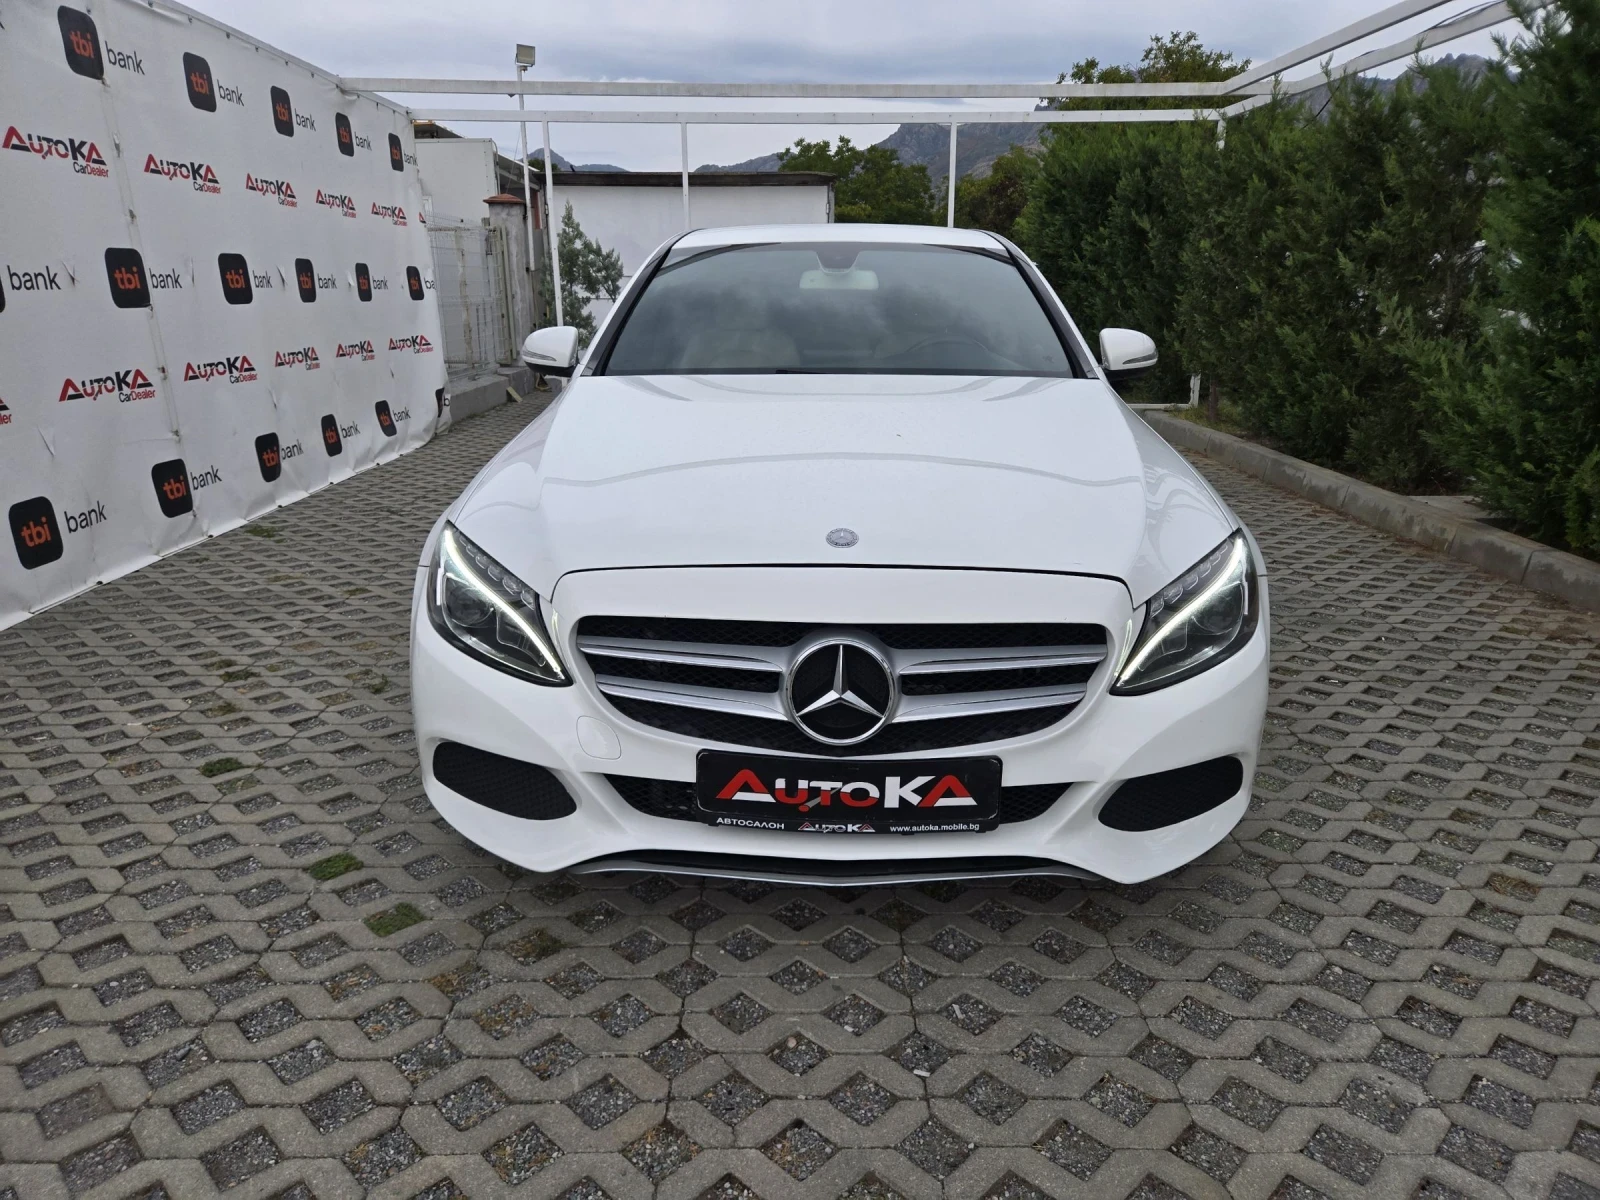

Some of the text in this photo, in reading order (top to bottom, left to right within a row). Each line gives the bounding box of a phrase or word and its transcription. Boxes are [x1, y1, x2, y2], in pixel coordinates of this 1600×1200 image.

[69, 31, 145, 75] tbi bank
[190, 71, 244, 106] tbi bank
[276, 102, 316, 131] tbi bank
[354, 132, 372, 151] bank
[7, 265, 62, 291] bank
[114, 267, 182, 289] tbi bank
[225, 269, 273, 289] tbi bank
[300, 272, 338, 289] tbi bank
[372, 275, 388, 290] bank
[392, 407, 411, 422] bank
[326, 421, 360, 444] tbi bank
[262, 448, 279, 467] tbi
[163, 465, 222, 500] tbi bank
[21, 501, 107, 547] tbi bank
[715, 768, 978, 813] AUTOKA
[716, 816, 785, 830] АВТОСАЛОН
[889, 822, 980, 833] www.autoka.mobile.bg
